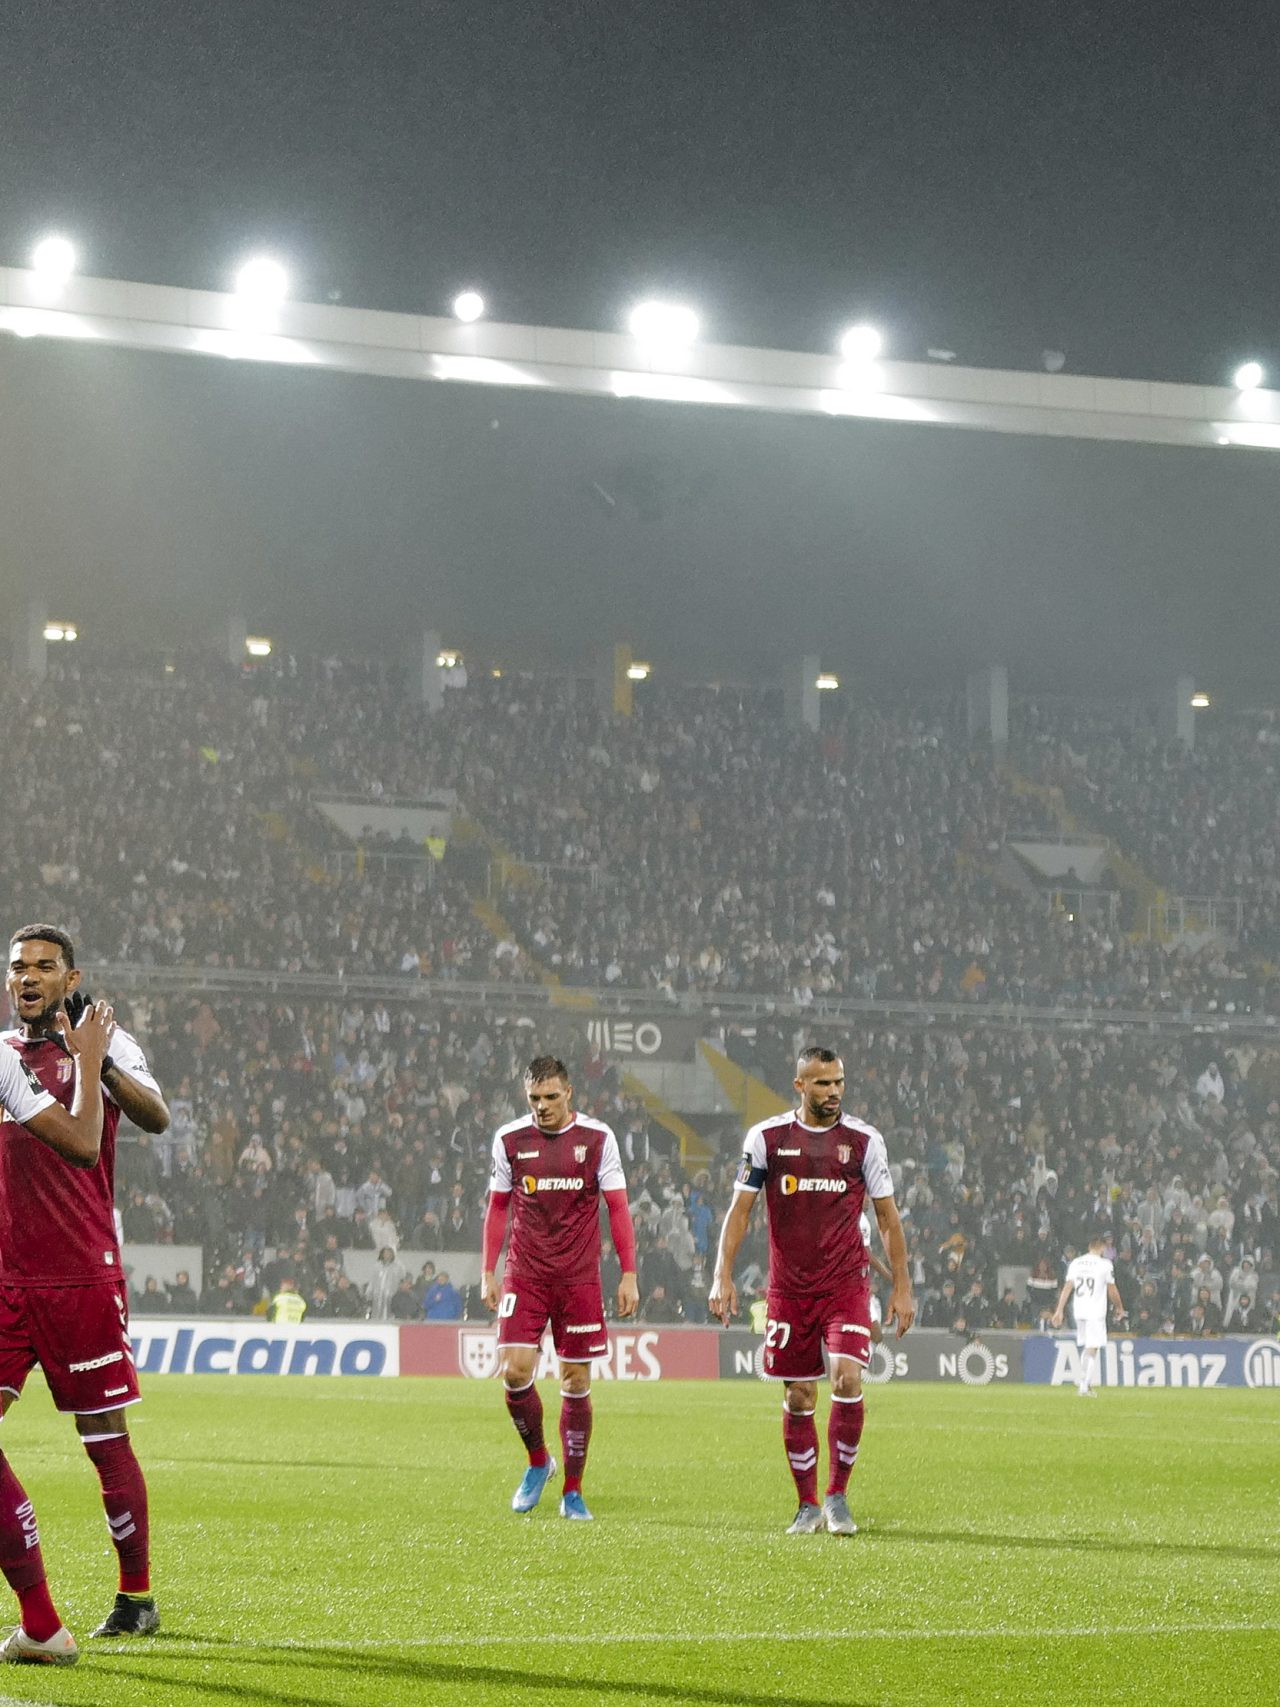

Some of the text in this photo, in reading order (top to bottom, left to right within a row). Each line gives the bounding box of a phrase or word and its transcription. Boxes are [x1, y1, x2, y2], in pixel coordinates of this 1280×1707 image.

[537, 1177, 584, 1191] BETANO
[798, 1178, 847, 1193] BETANO
[1075, 1276, 1095, 1298] 29
[766, 1319, 791, 1350] 27
[69, 1351, 123, 1373] PROZIS
[939, 1342, 1009, 1386] NOS
